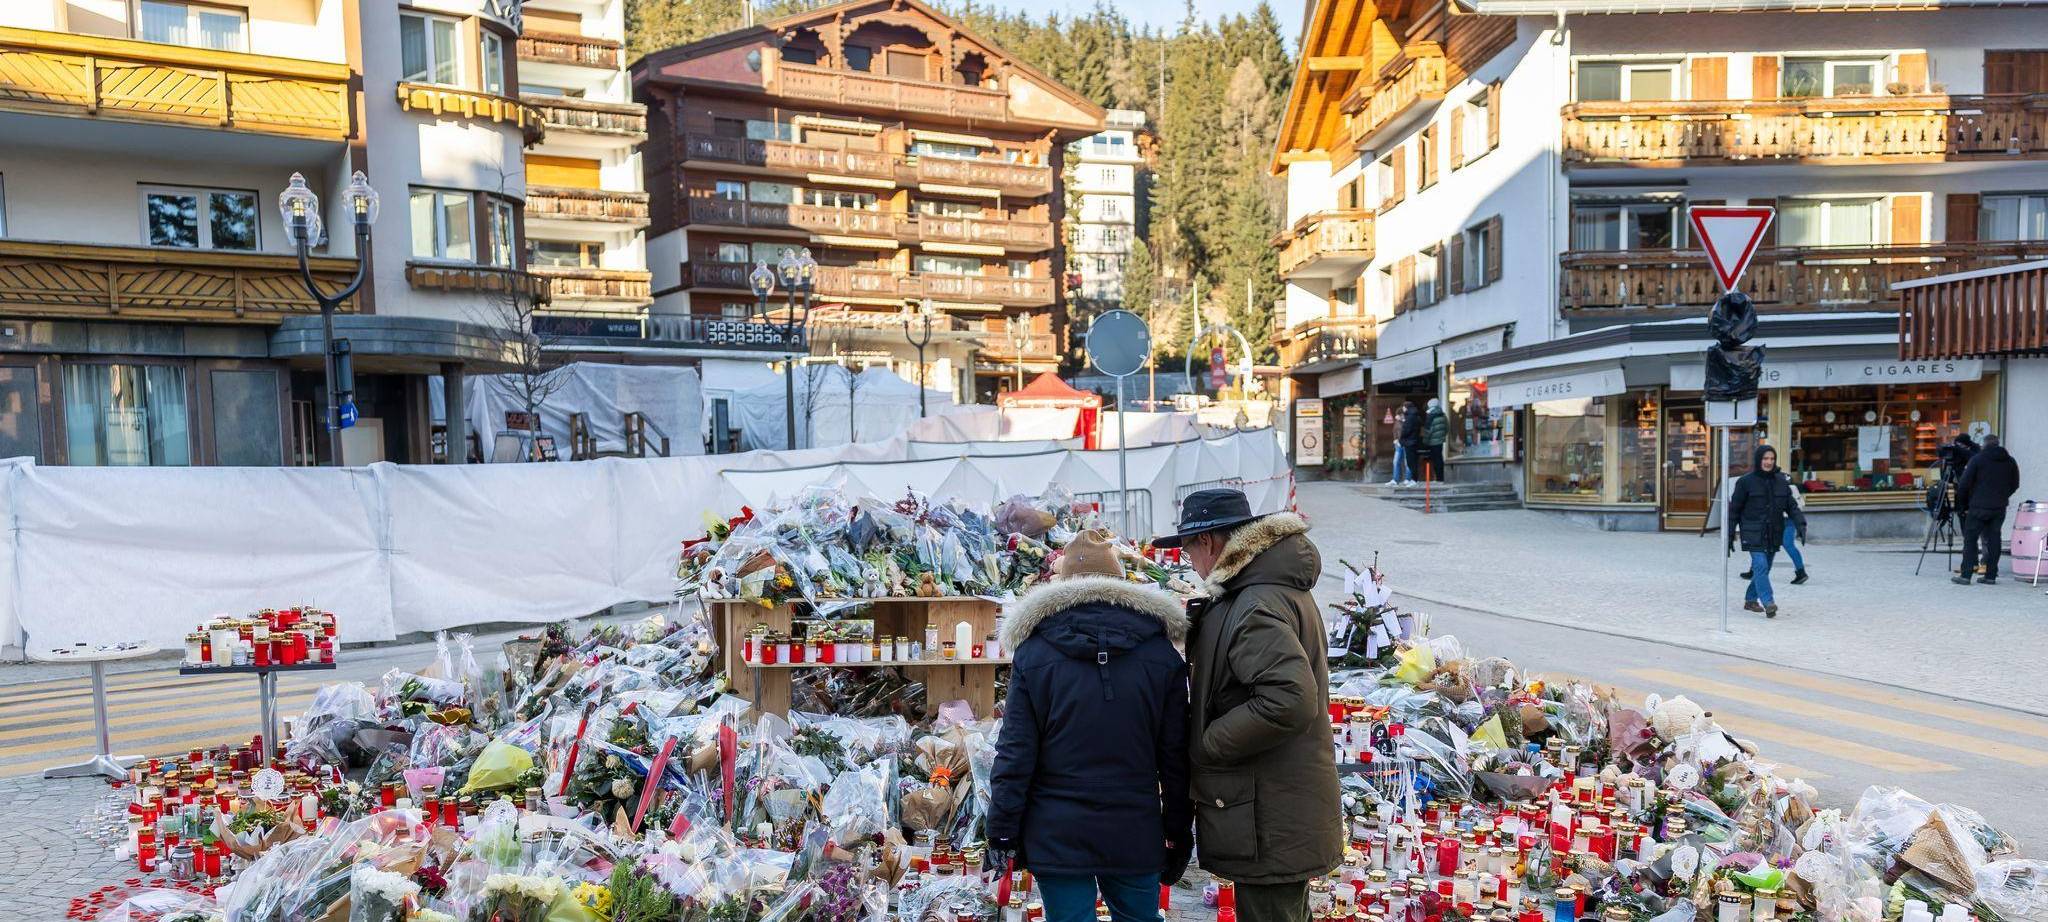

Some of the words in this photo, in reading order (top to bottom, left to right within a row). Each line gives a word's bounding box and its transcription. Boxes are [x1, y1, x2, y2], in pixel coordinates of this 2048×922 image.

[607, 324, 624, 332] WINE
[624, 324, 638, 332] BAR
[1864, 363, 1954, 376] CIGARES
[1526, 382, 1573, 397] CIGARES
